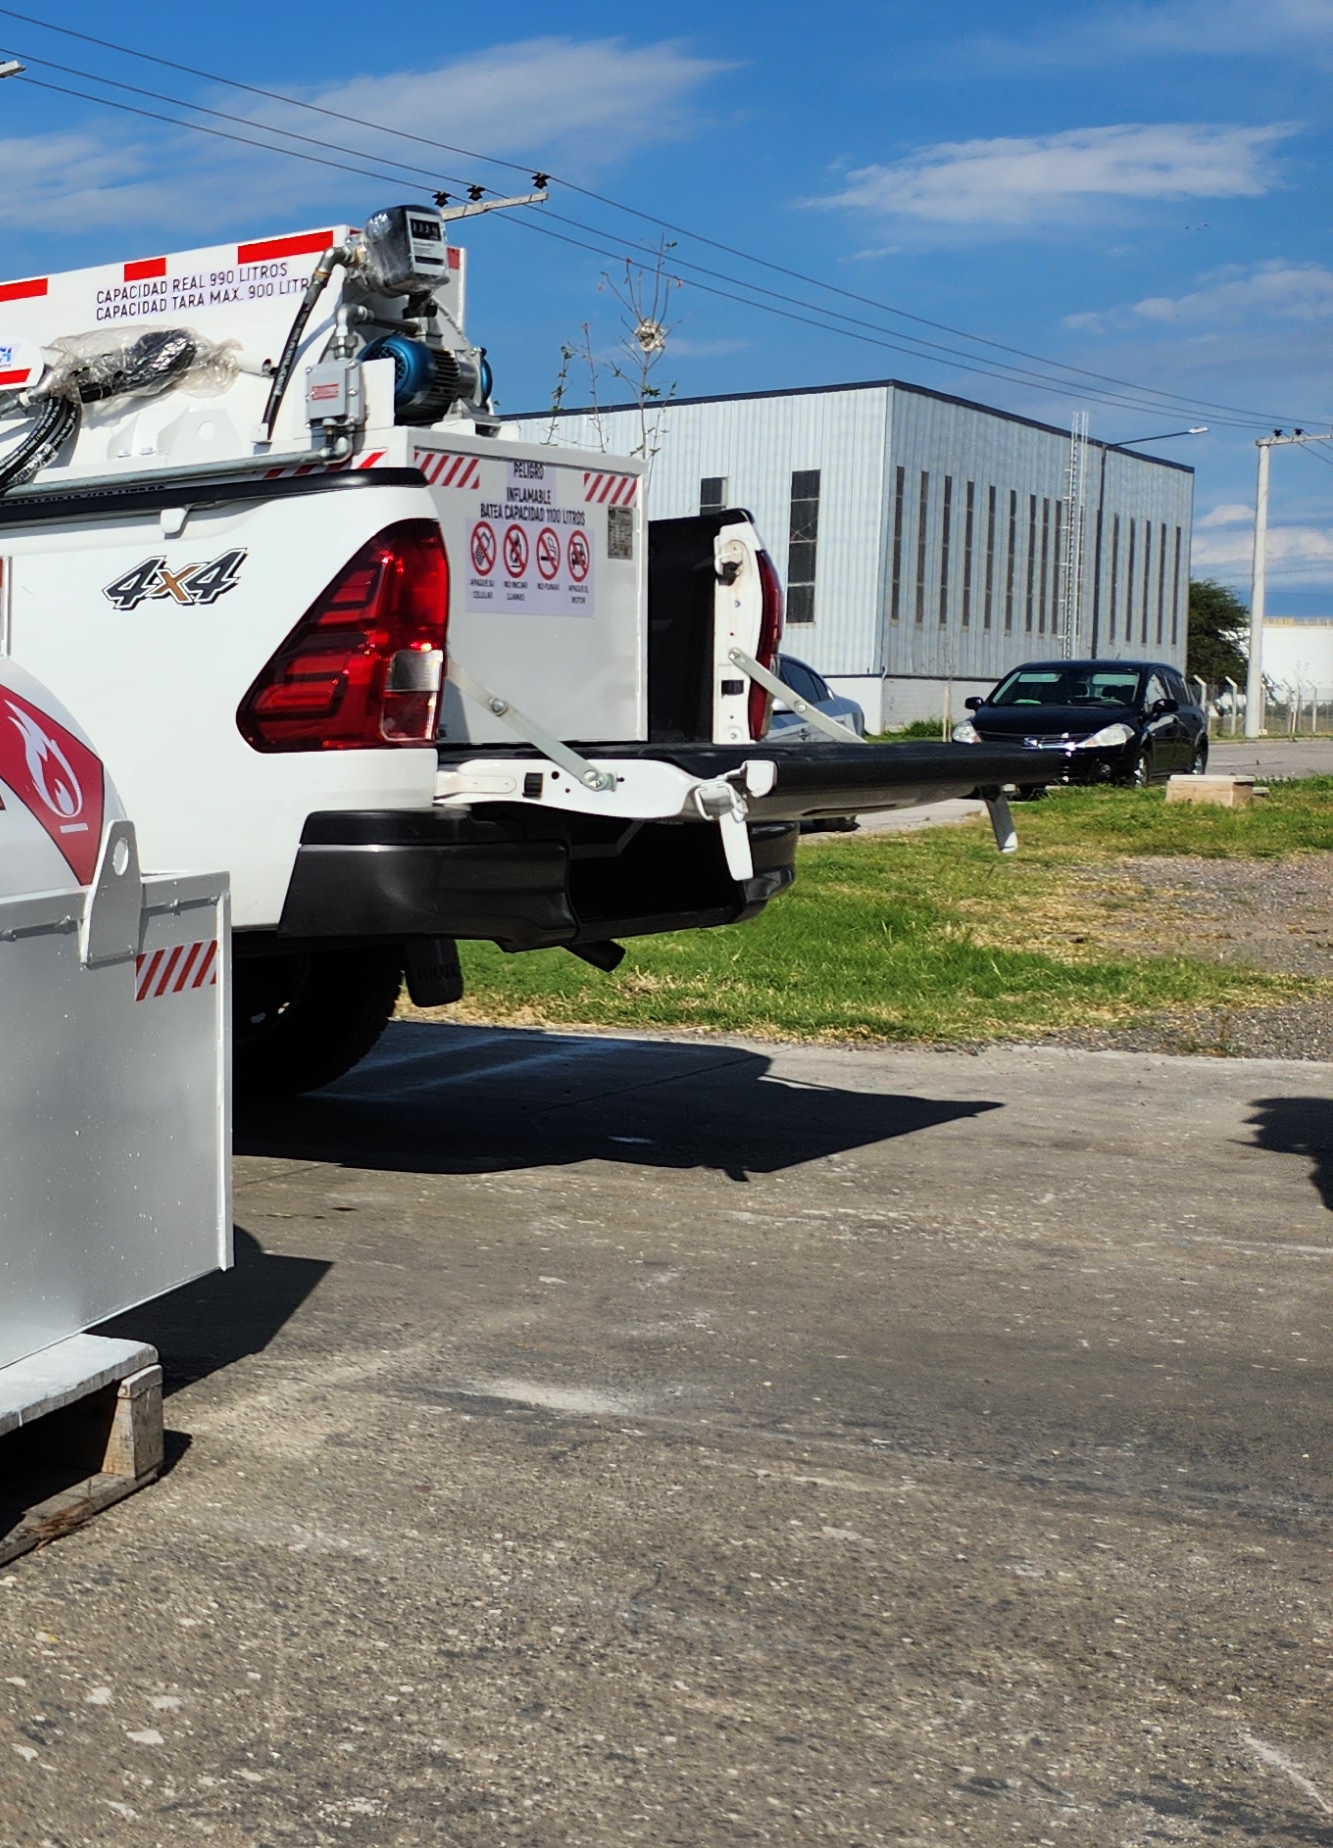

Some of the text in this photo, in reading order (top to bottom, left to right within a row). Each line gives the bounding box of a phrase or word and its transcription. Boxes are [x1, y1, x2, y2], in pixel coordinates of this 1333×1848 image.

[96, 262, 288, 304] CAPACIDAD REAL 990 LITROS
[96, 277, 312, 321] CAPACIDAD TARA MAX. 900 LITR
[513, 462, 545, 480] PELIGRO
[506, 486, 552, 505] INFLAMABLE
[480, 503, 503, 519] BATEA
[505, 506, 545, 522] CAPACIDAD
[562, 511, 586, 526] LITROS
